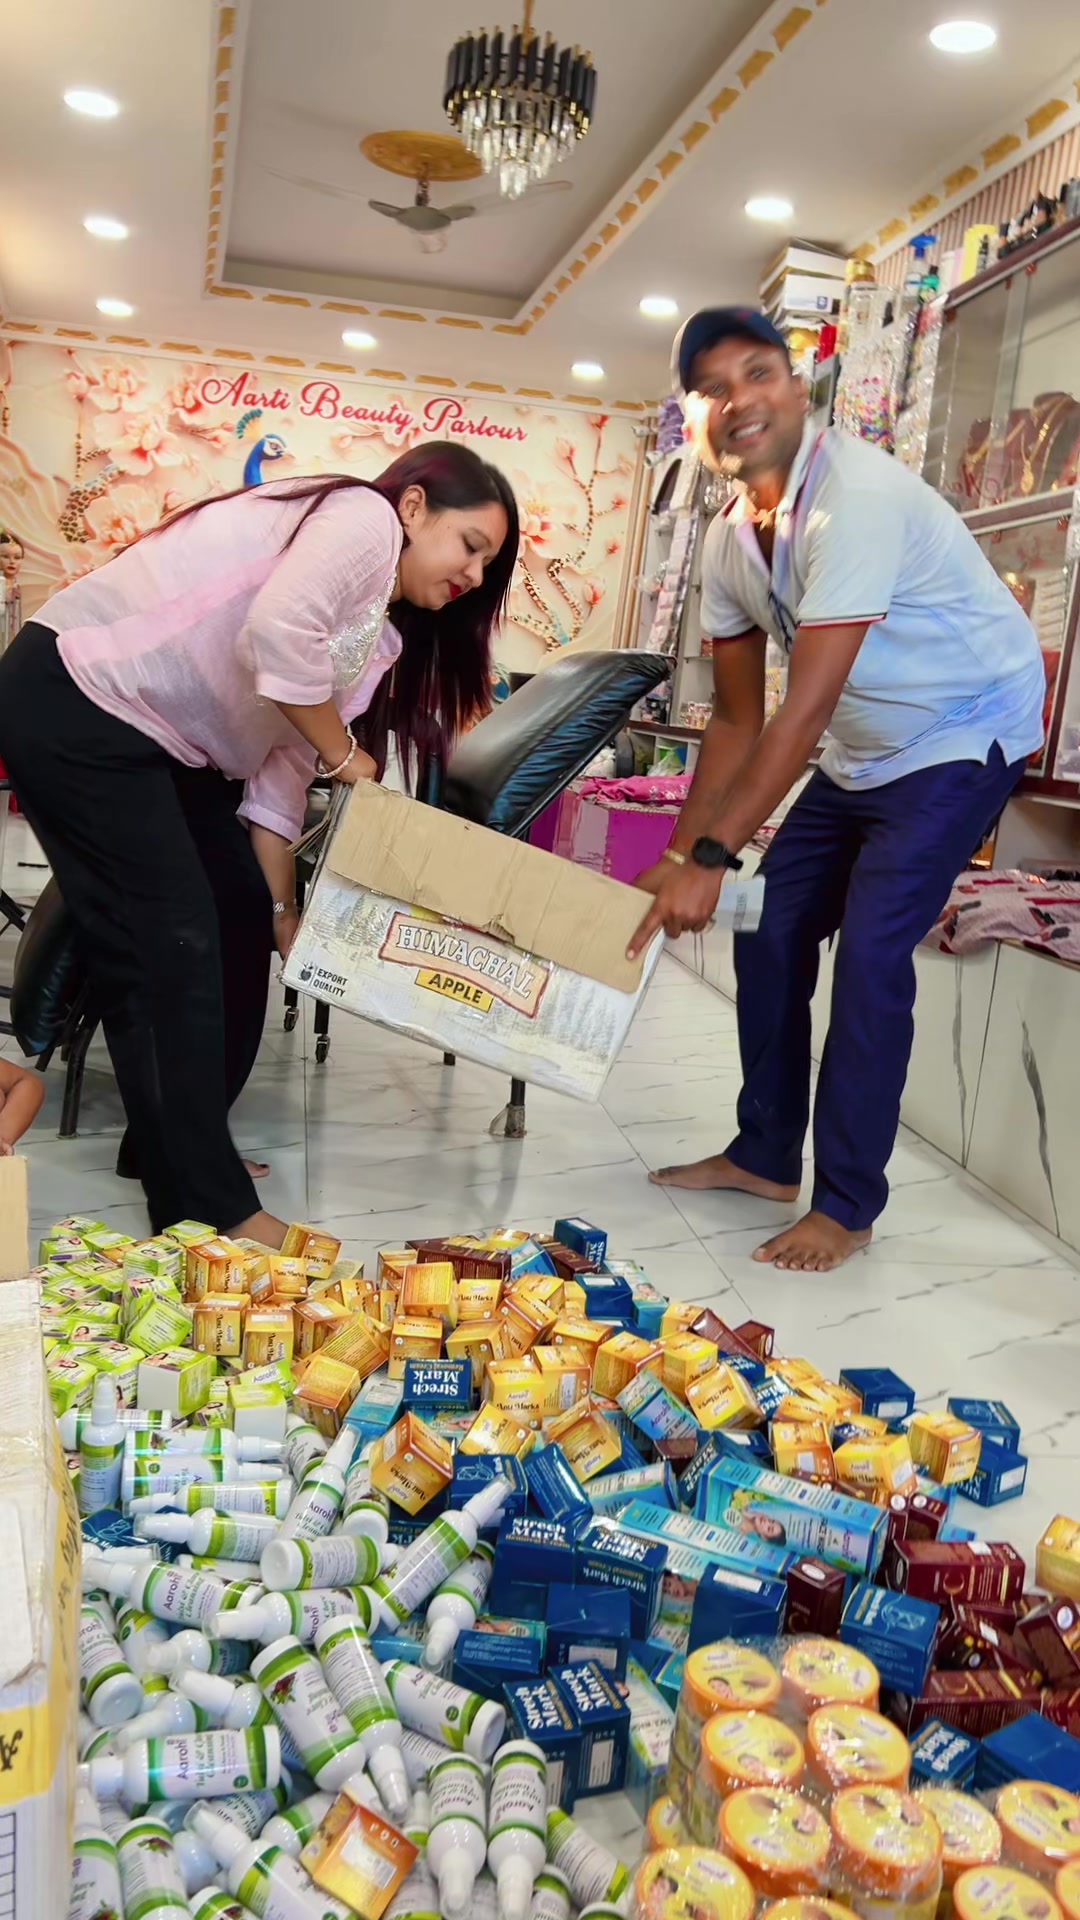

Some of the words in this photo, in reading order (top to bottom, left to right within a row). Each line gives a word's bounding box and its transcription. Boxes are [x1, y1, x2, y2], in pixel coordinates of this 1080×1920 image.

[201, 371, 291, 411] Aarti
[300, 381, 413, 435] Beauty
[422, 397, 528, 442] Parlour
[316, 967, 350, 987] EXPORT
[396, 925, 537, 998] HIMACHAL
[312, 978, 347, 998] QUALITY
[428, 973, 484, 1005] APPLE
[413, 1370, 459, 1383] Mark
[413, 1383, 459, 1397] Strech
[309, 1501, 336, 1521] Aarohi
[512, 1518, 566, 1534] Strech
[392, 1533, 413, 1545] rk
[511, 1528, 565, 1543] Mark
[592, 1539, 645, 1562] Strech
[598, 1530, 650, 1553] Mark
[164, 1573, 183, 1610] Aarohi
[187, 1576, 205, 1618] Cleansing
[612, 1575, 647, 1593] Strech
[561, 1669, 594, 1712] Strech
[576, 1664, 610, 1709] Mark
[515, 1686, 544, 1729] Strech
[532, 1685, 562, 1727] Mark
[177, 1738, 188, 1780] Aarohi
[914, 1726, 955, 1762] Mark
[931, 1736, 971, 1772] Strech
